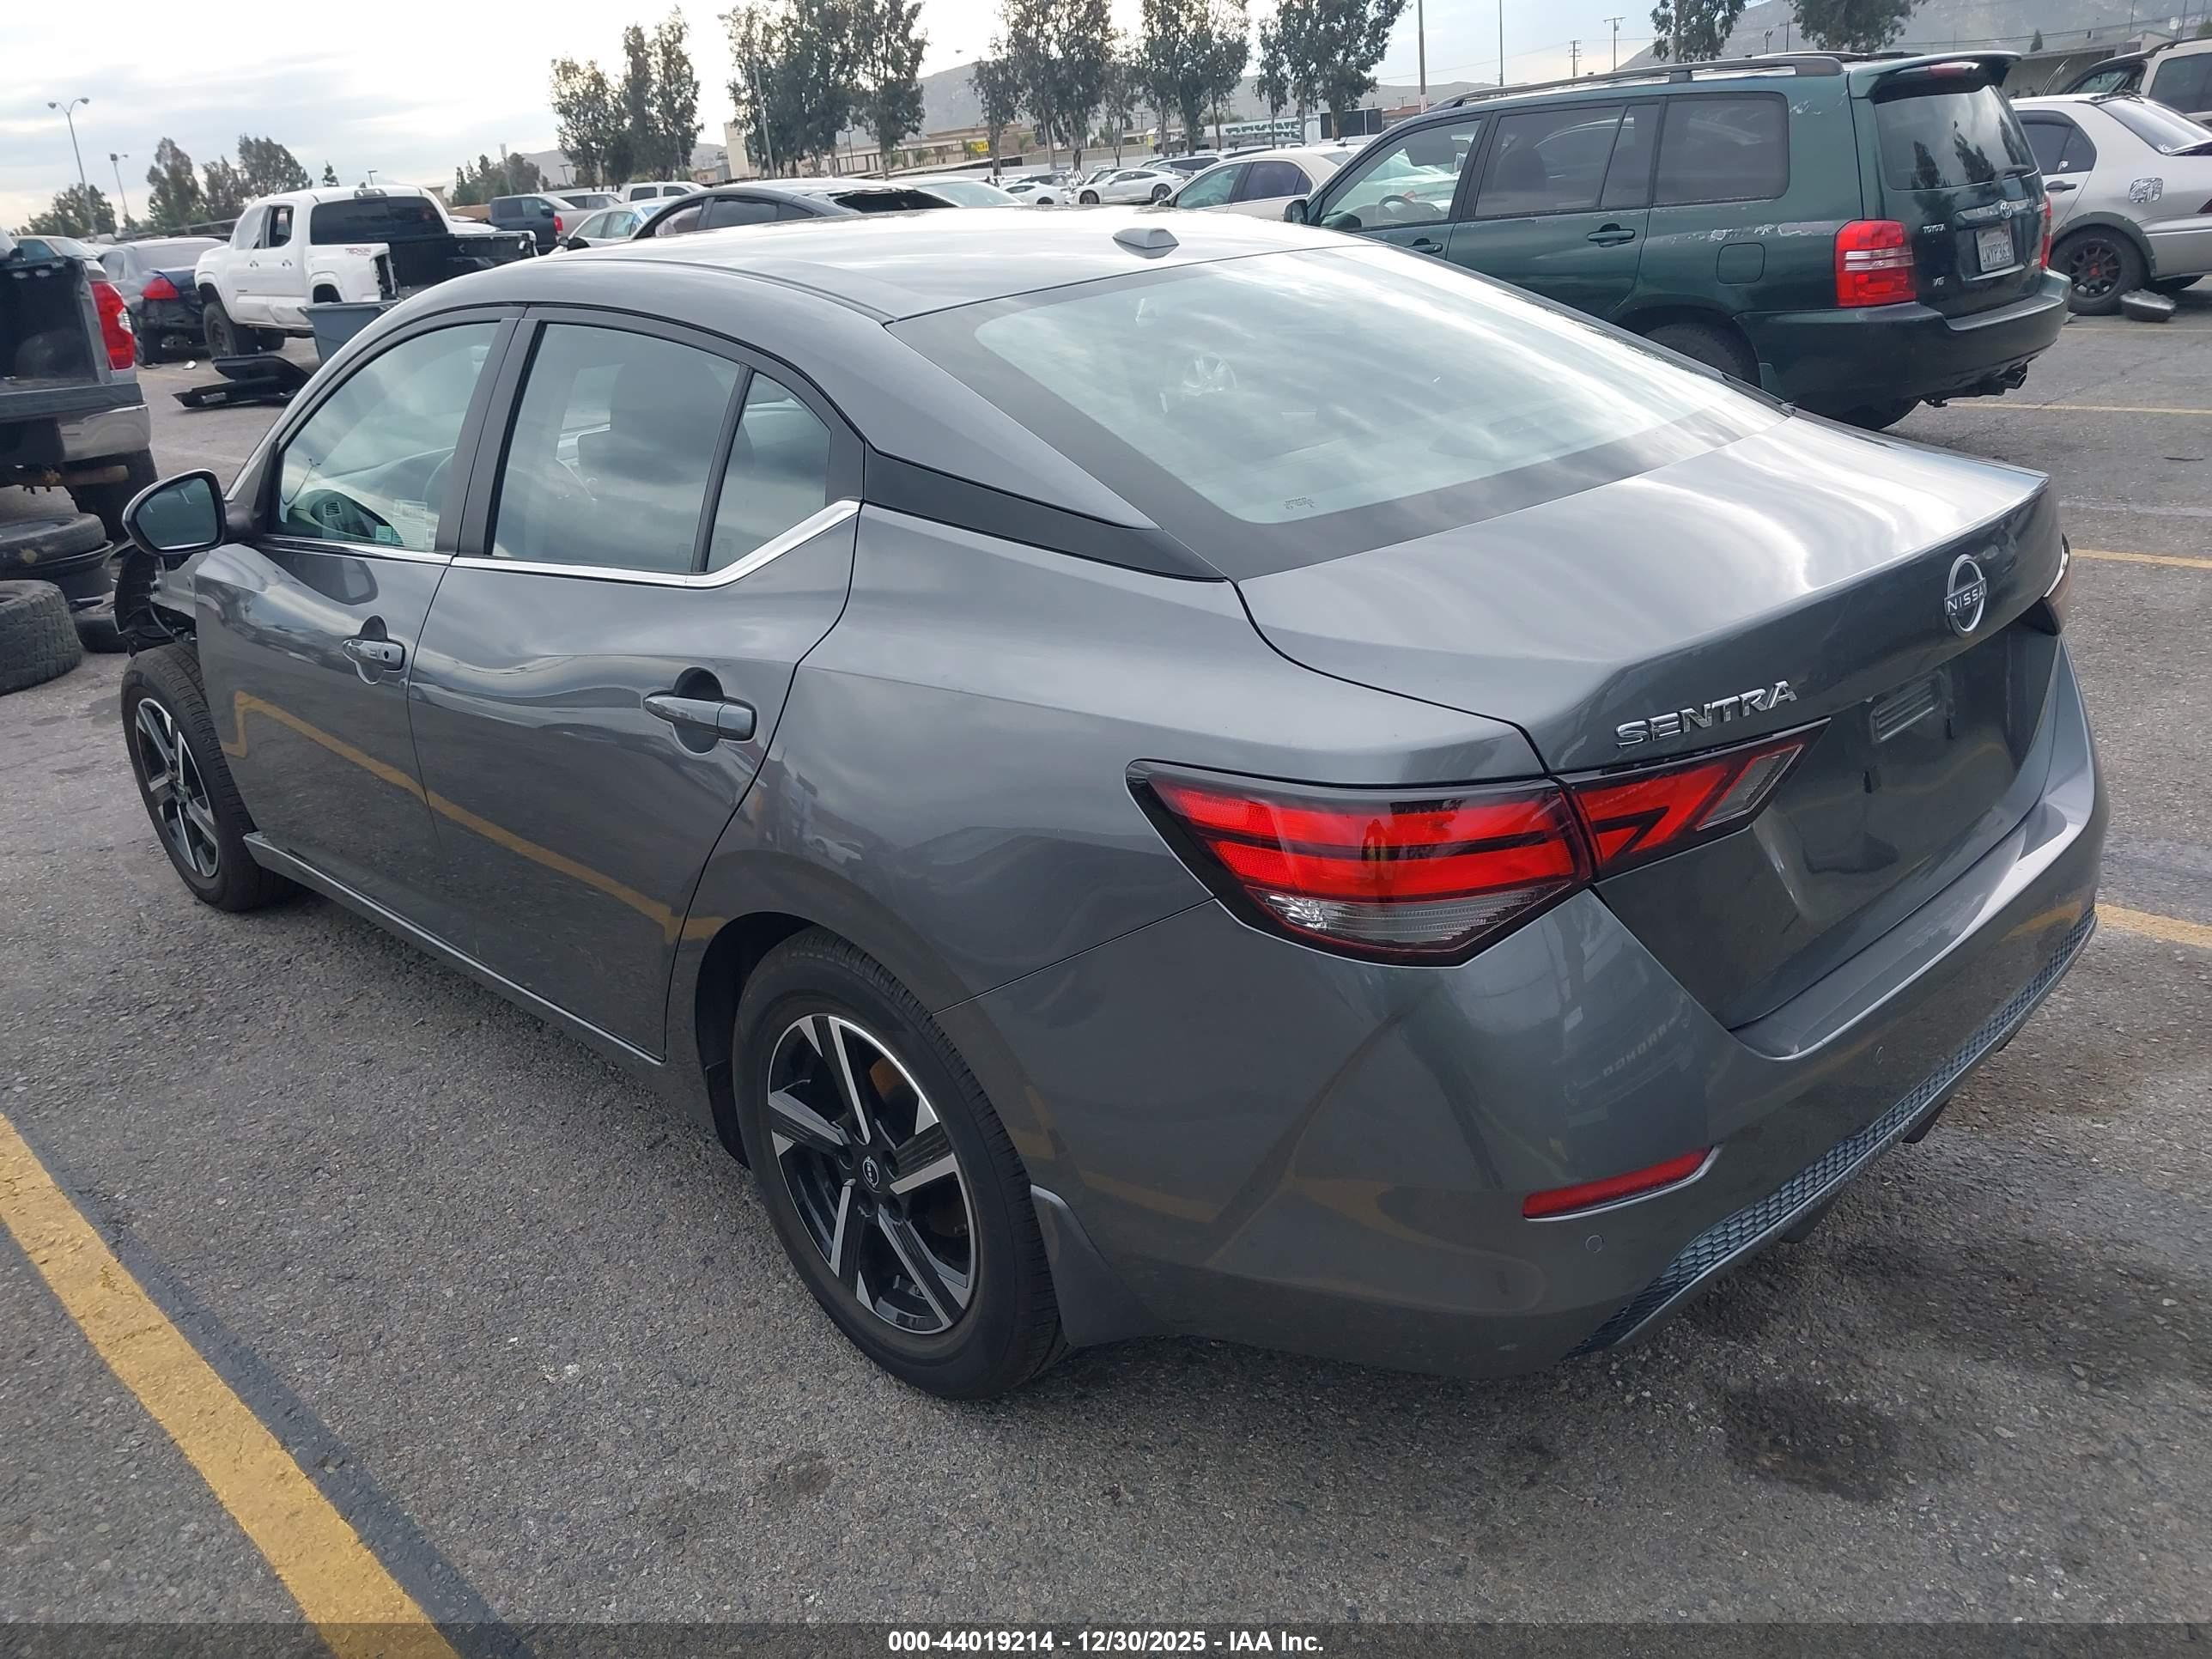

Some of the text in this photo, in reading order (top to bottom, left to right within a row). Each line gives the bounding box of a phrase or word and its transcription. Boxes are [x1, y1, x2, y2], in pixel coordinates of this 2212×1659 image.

[1923, 223, 1947, 234] TOYOTA
[1932, 276, 1945, 288] V6
[1947, 582, 1987, 613] NISSAN
[1614, 679, 1798, 749] SENTRA
